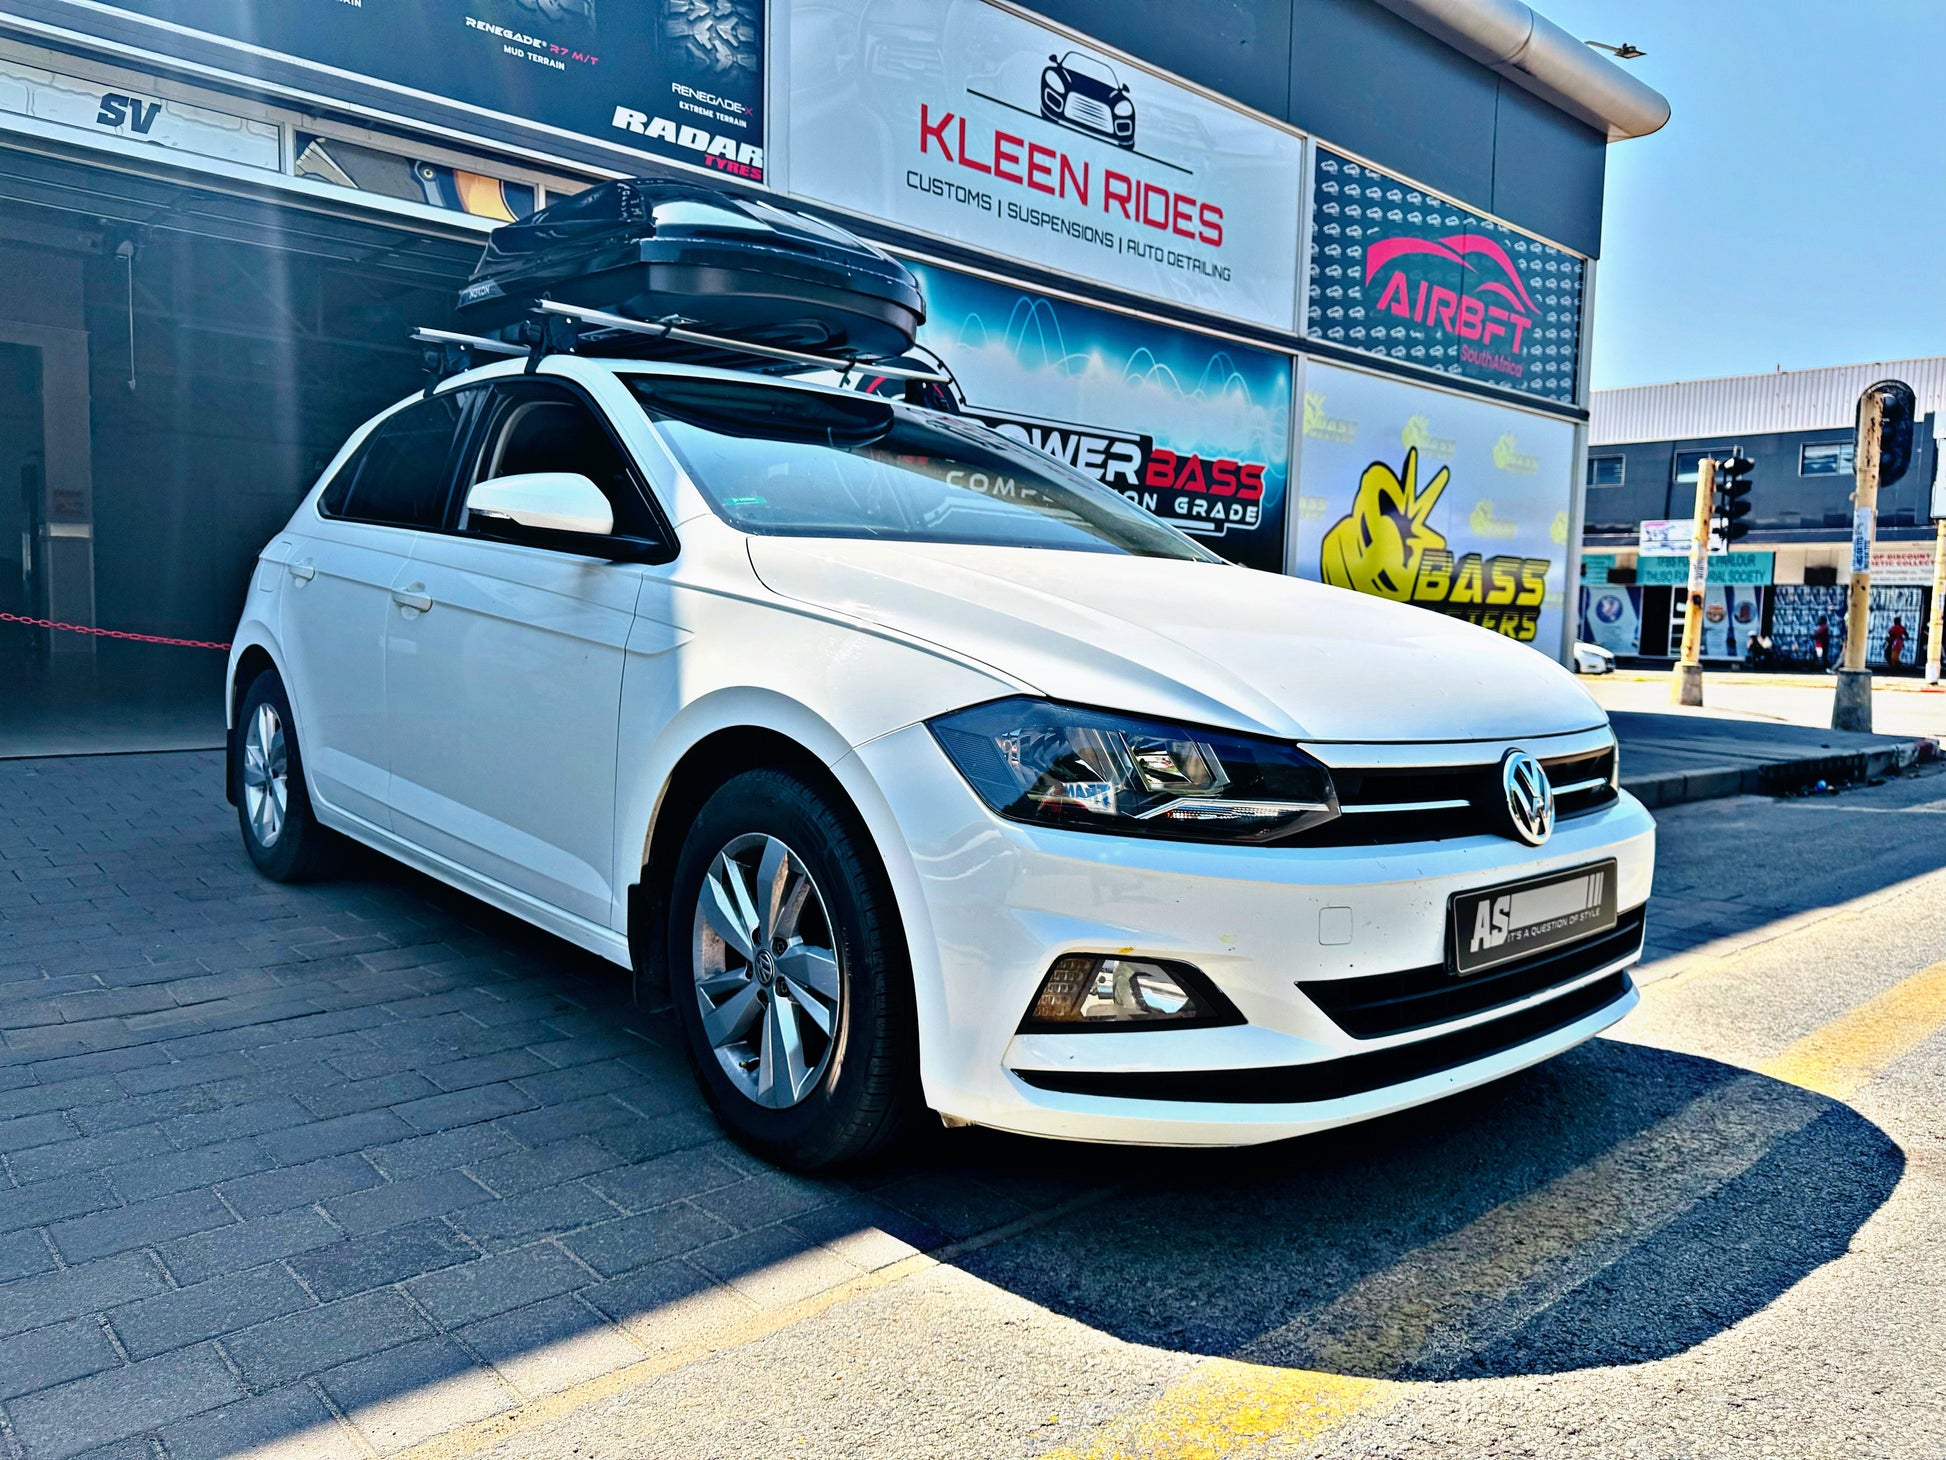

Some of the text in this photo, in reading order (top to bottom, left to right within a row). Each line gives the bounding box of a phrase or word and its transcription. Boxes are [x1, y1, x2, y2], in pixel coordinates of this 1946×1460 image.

[503, 44, 565, 71] MUD TERRAIN
[550, 43, 569, 56] R7
[571, 51, 599, 65] M/T
[96, 92, 162, 134] SV
[678, 101, 747, 128] EXTREME TERRAIN
[611, 105, 764, 169] RADAR
[704, 154, 763, 181] TYRES
[920, 103, 1225, 248] KLEEN RIDES
[906, 170, 1232, 282] CUSTOMS SUSPENSIONS AUTO DETAILING
[1376, 270, 1532, 354] AIRBFT
[1174, 496, 1259, 523] GRADE
[1413, 549, 1552, 607] BASS
[1530, 918, 1568, 936] QUESTION
[1568, 914, 1579, 925] OF
[1579, 907, 1601, 922] STYLE
